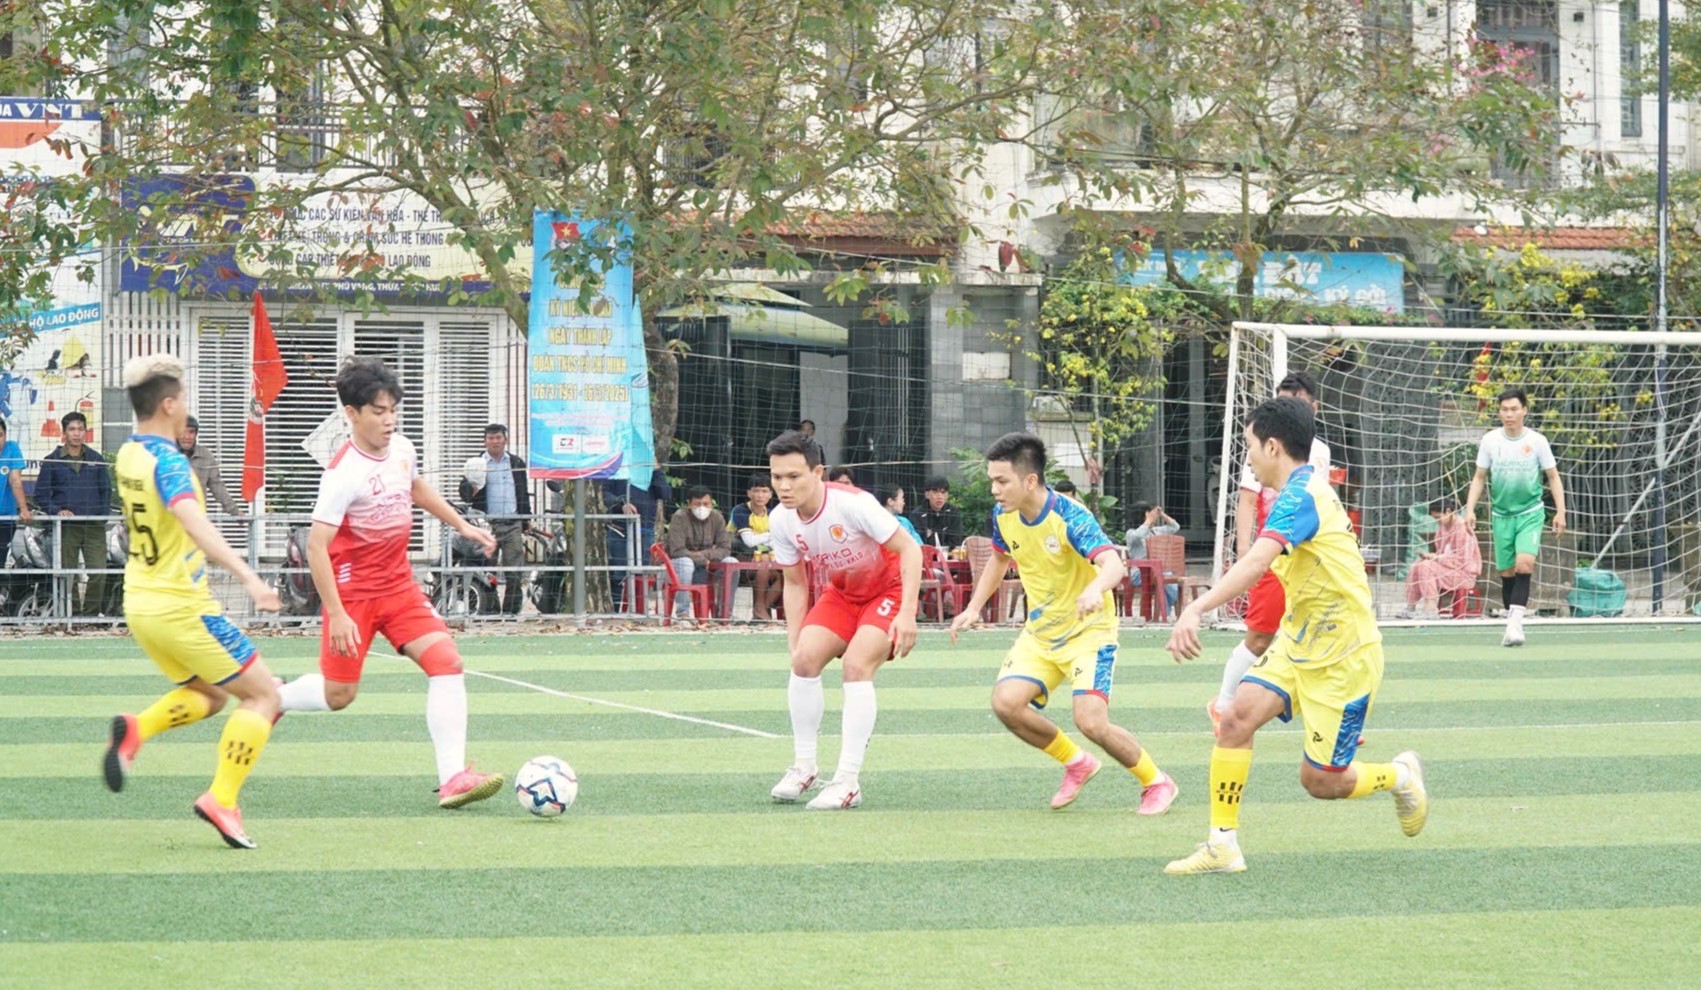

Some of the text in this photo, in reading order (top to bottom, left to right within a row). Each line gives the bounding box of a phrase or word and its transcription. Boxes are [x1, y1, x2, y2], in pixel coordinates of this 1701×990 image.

[14, 103, 84, 118] VNT
[46, 313, 66, 326] LAO
[796, 534, 809, 551] 5
[877, 598, 895, 617] 5
